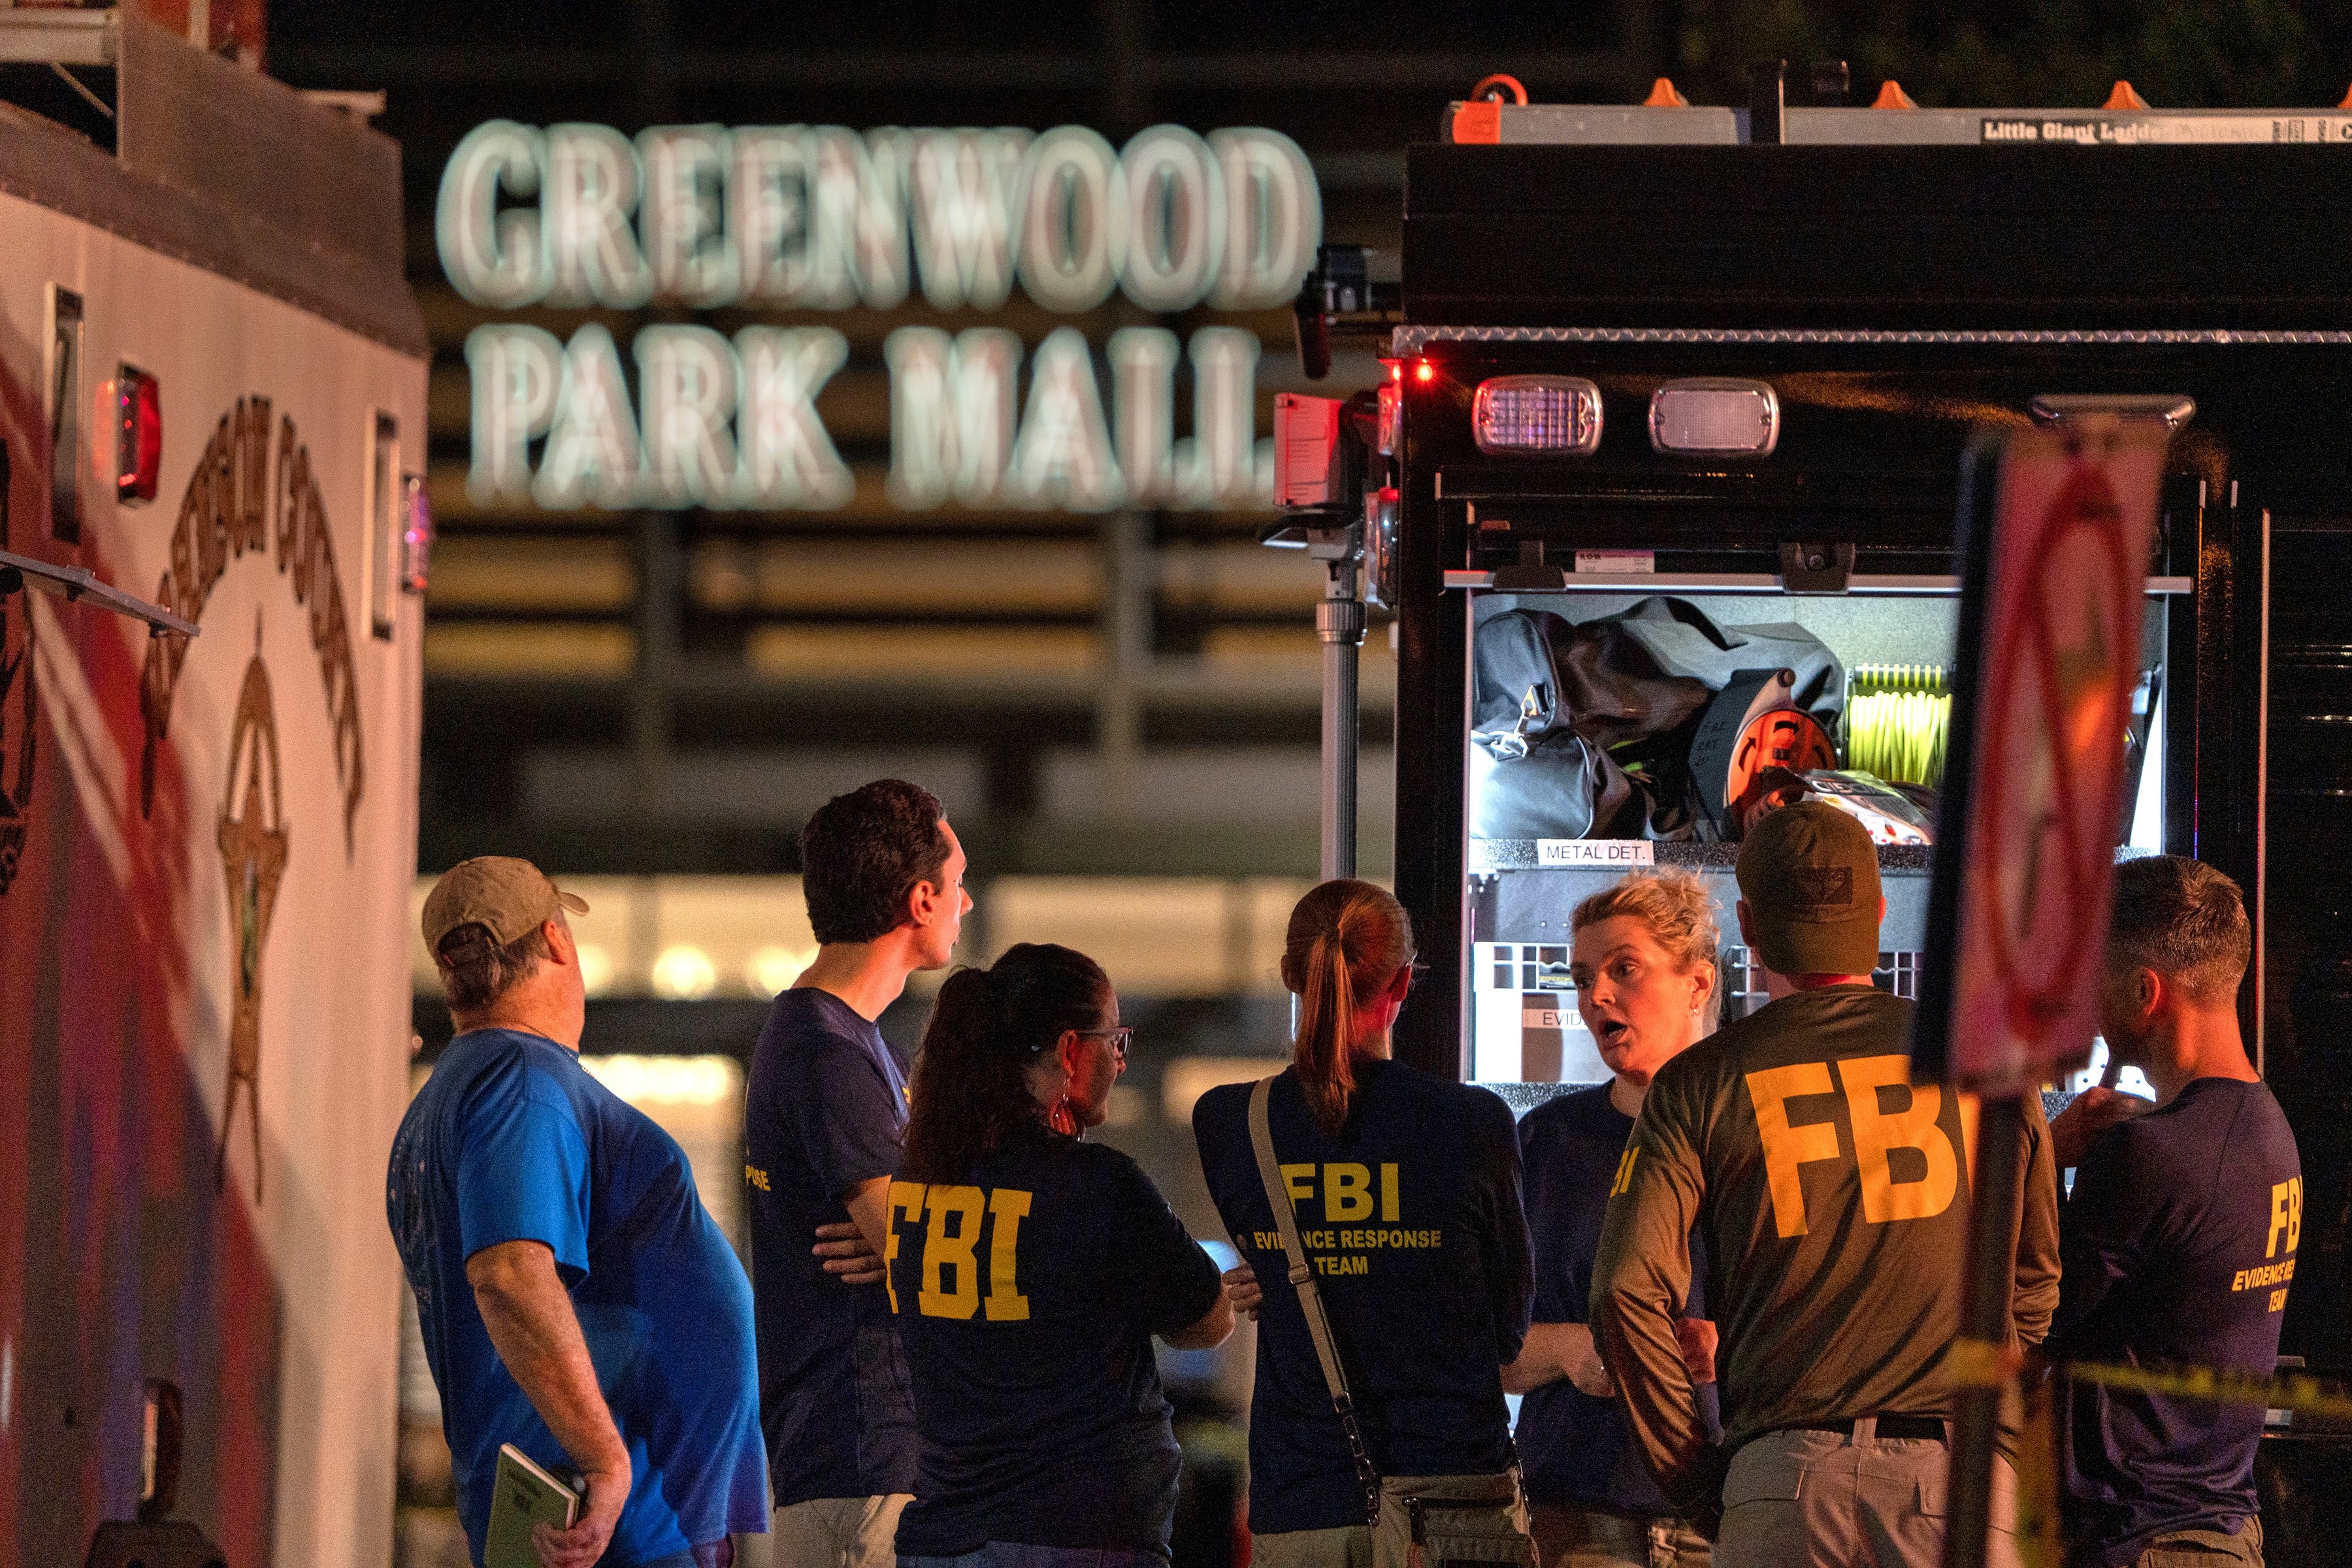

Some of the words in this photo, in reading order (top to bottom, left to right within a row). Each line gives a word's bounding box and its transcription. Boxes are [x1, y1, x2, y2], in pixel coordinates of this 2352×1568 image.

[1984, 122, 2038, 140] Little
[436, 119, 1323, 313] GREENWOOD
[464, 323, 856, 512] PARK
[883, 326, 1274, 514] MALL
[1546, 845, 1603, 859] METAL
[1608, 845, 1645, 860] DET.
[1744, 1053, 1982, 1239] FB
[1278, 1162, 1400, 1222] FBI
[883, 1181, 1034, 1322] FBI
[1253, 1230, 1337, 1250] EVINCE
[1341, 1229, 1442, 1249] RESPONSE
[1313, 1255, 1369, 1276] TEAM
[2231, 1262, 2286, 1292] EVIDENCE
